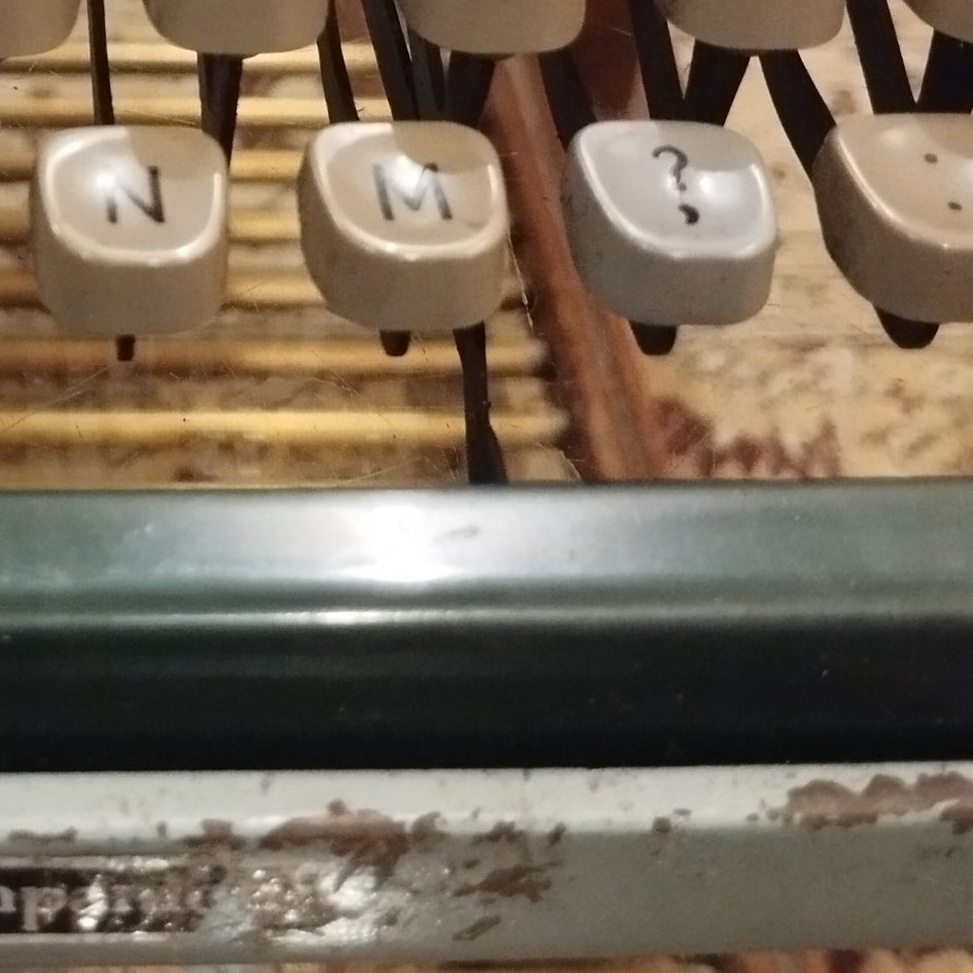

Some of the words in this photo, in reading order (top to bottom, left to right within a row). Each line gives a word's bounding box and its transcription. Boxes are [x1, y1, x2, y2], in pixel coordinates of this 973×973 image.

[106, 165, 166, 225] N
[372, 162, 453, 221] M
[651, 144, 688, 191] ?
